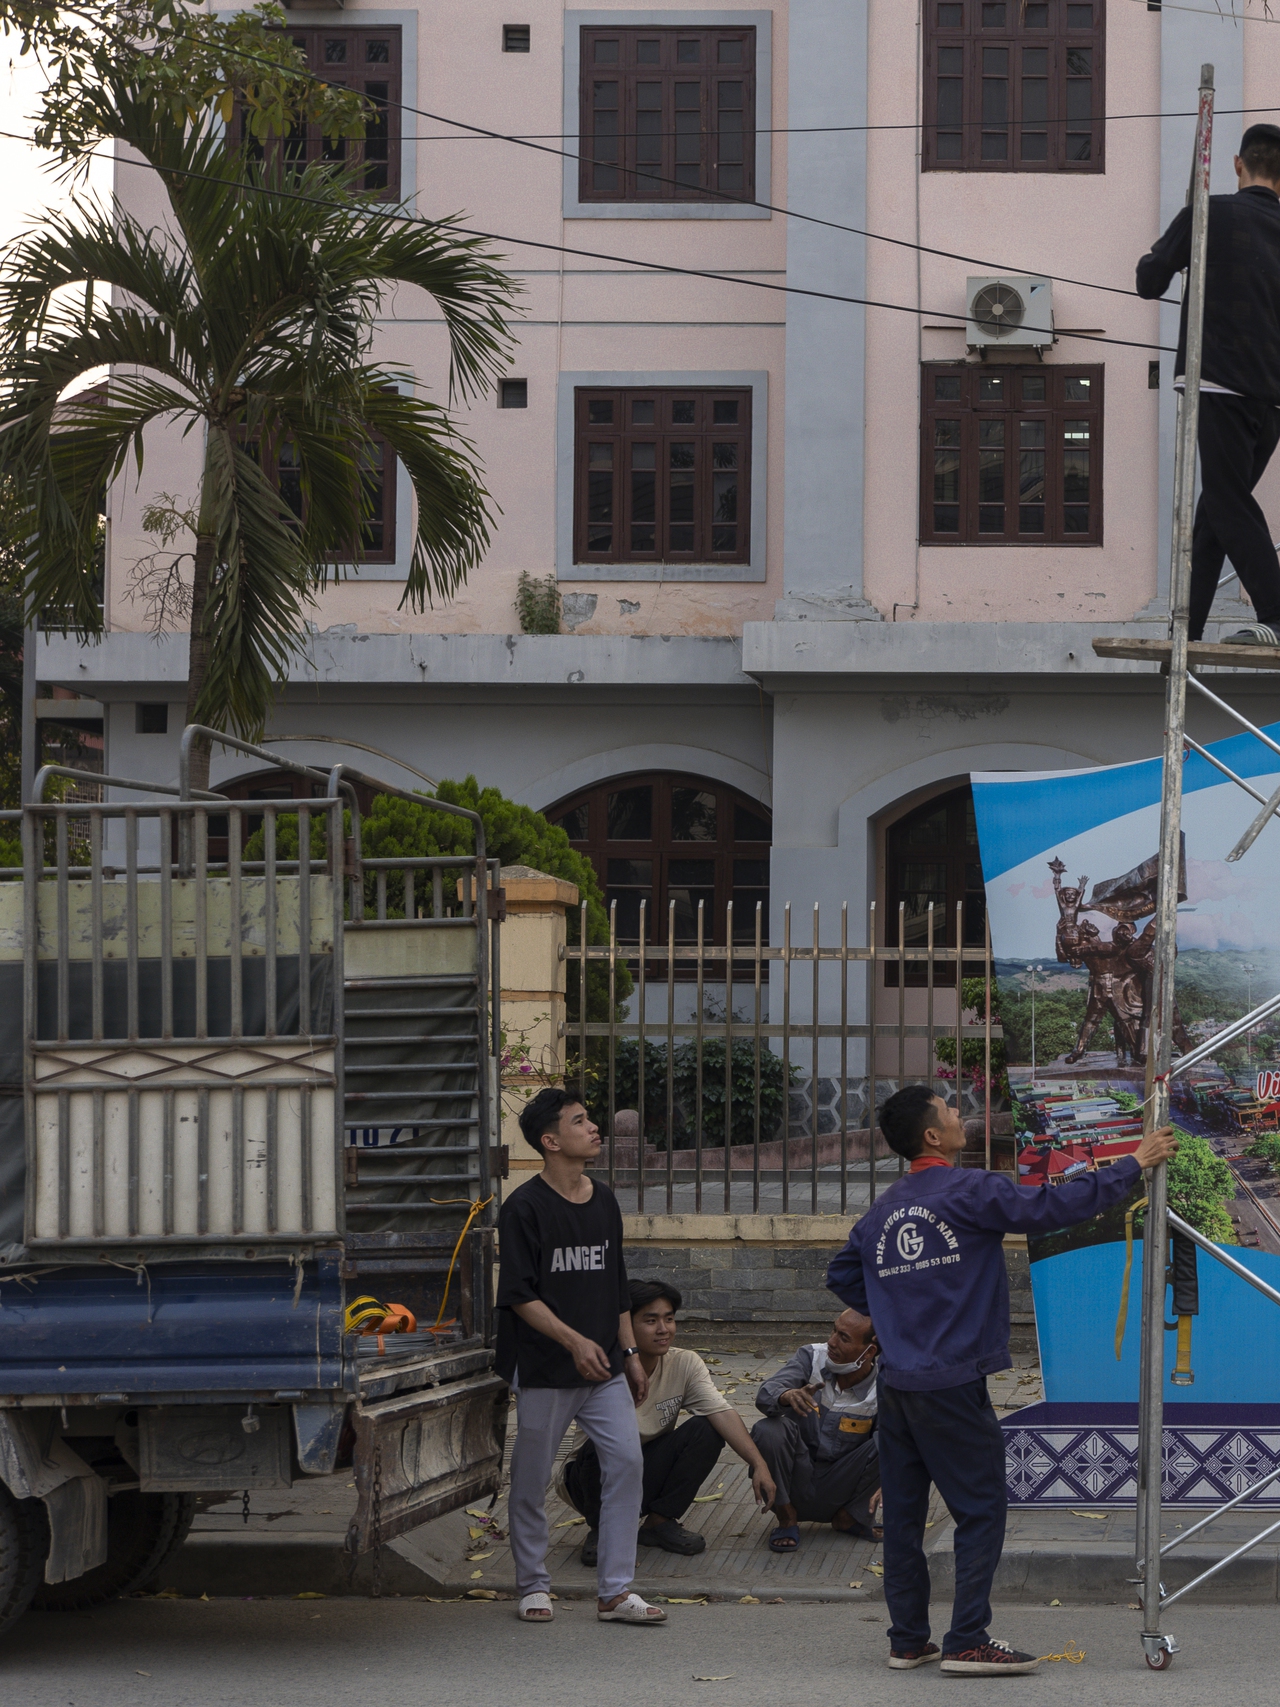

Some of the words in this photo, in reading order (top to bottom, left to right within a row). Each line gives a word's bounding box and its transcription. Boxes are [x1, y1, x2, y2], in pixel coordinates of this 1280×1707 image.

[908, 1206, 937, 1224] GIANG
[935, 1221, 959, 1250] NAM
[930, 1257, 940, 1266] 53
[941, 1253, 961, 1265] 0078
